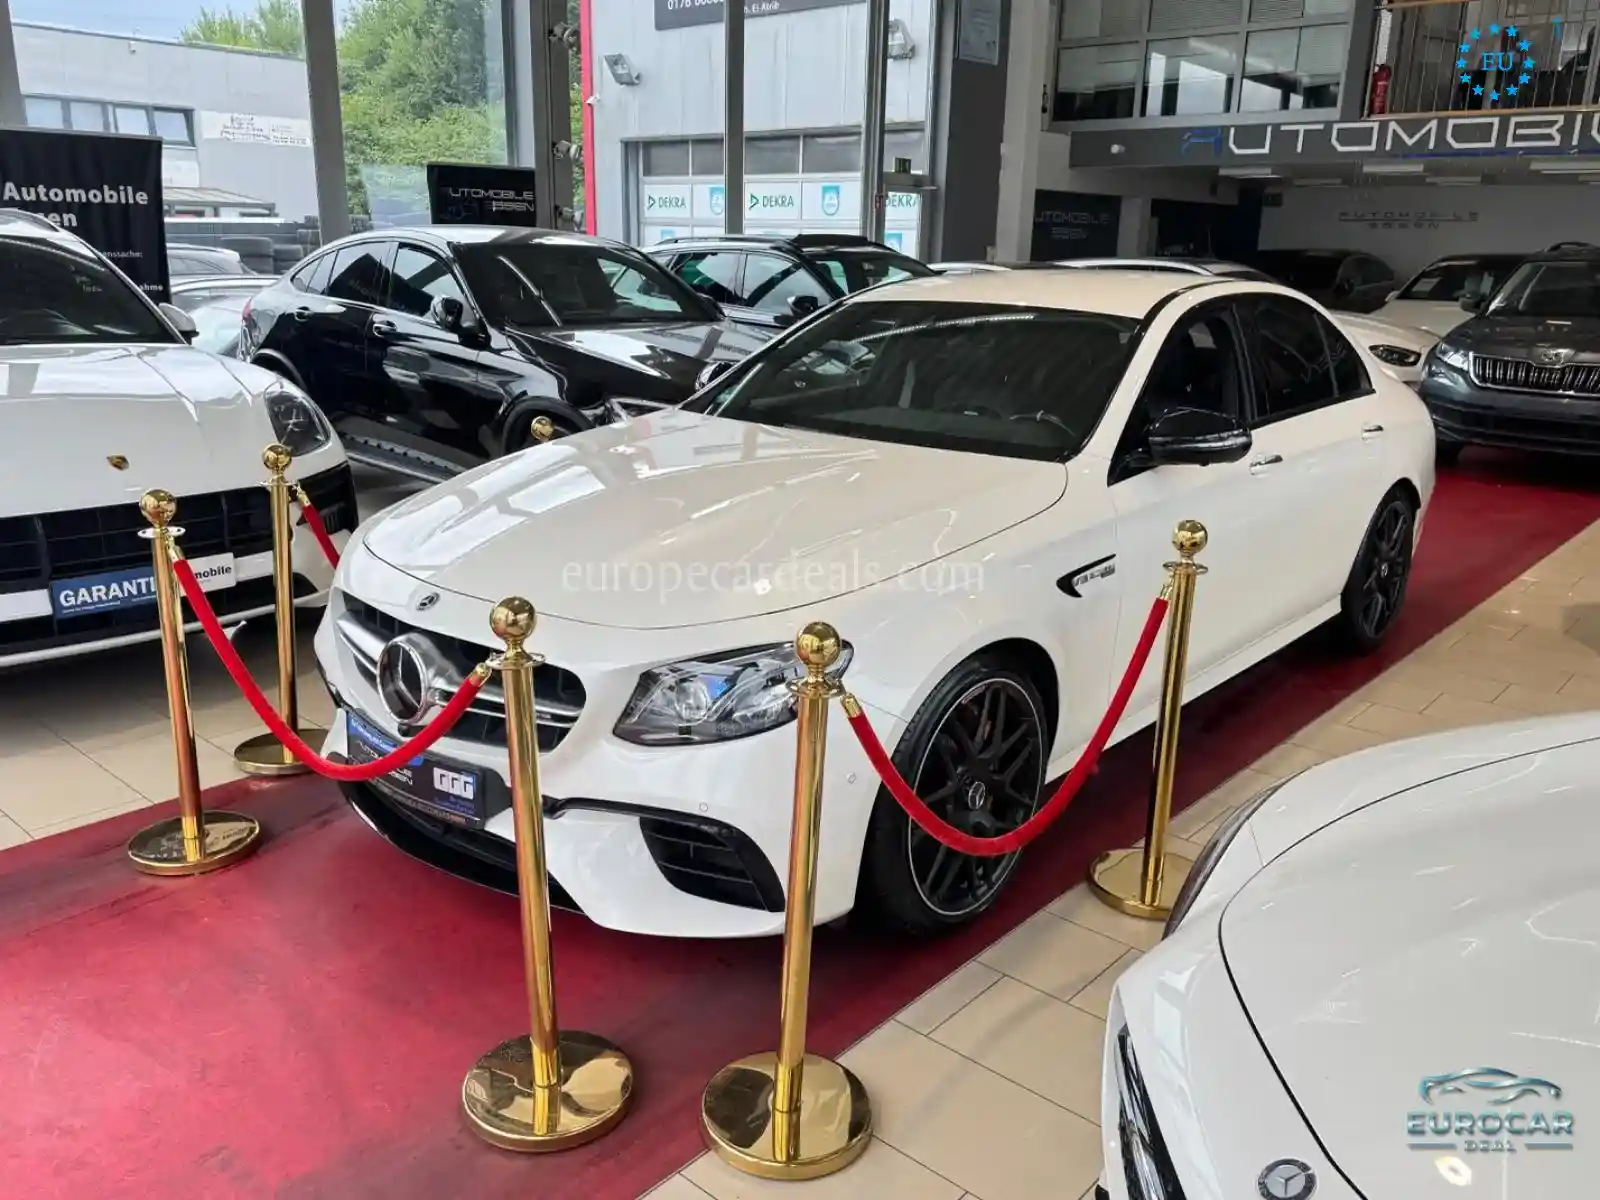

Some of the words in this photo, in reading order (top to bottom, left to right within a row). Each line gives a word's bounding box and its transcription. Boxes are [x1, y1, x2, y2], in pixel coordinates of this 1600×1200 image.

[3, 182, 149, 205] Automobile
[658, 197, 686, 208] DEKRA
[762, 195, 794, 207] DEKRA
